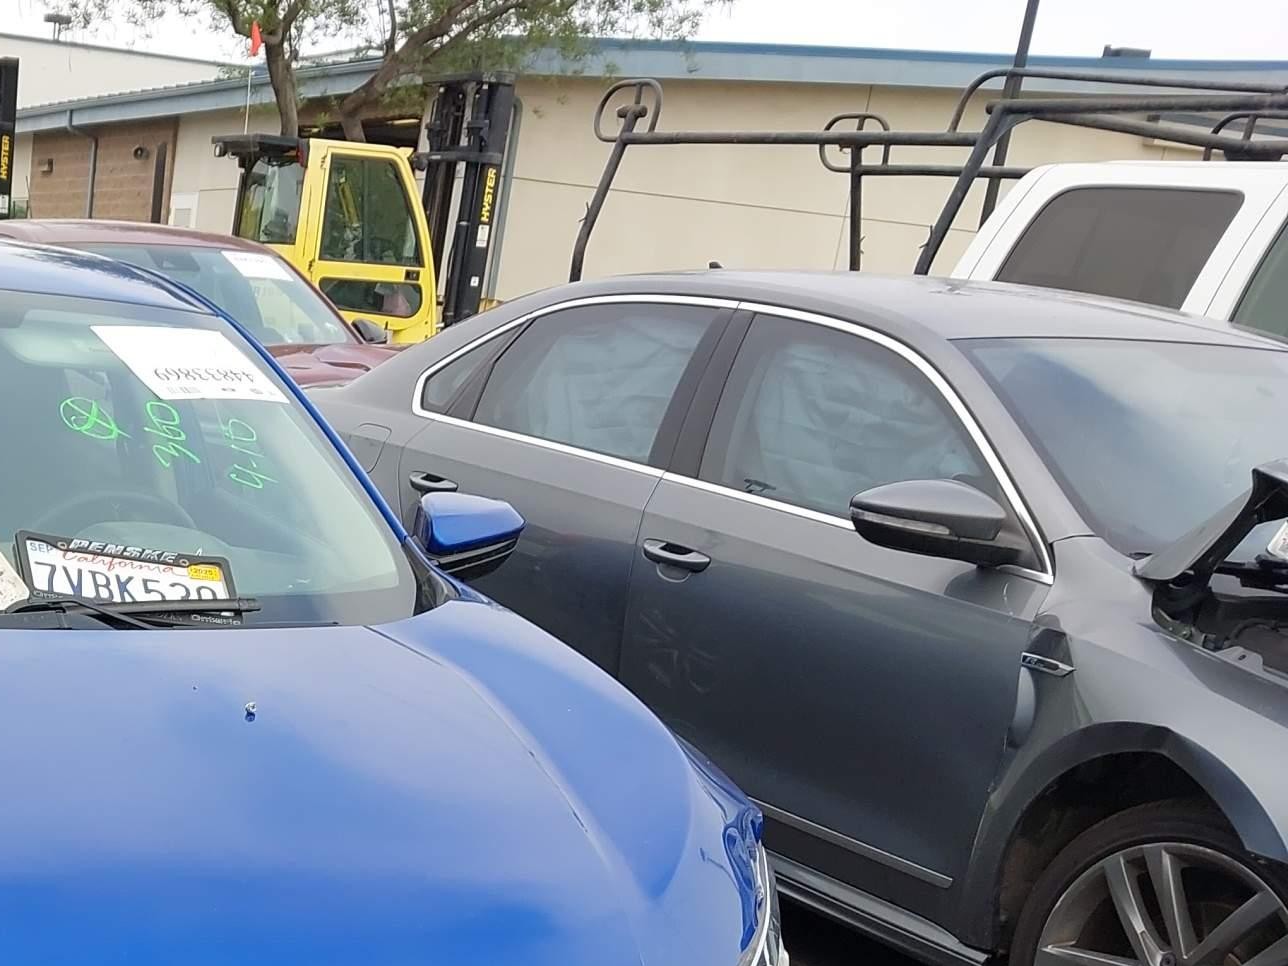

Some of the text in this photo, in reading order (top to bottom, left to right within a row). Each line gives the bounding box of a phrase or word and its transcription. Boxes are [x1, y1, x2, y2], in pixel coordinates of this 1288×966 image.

[0, 135, 10, 180] HYSTER
[480, 167, 497, 223] HYSTER
[153, 367, 254, 382] 44833869
[69, 538, 178, 563] PENSKE
[62, 551, 190, 577] California
